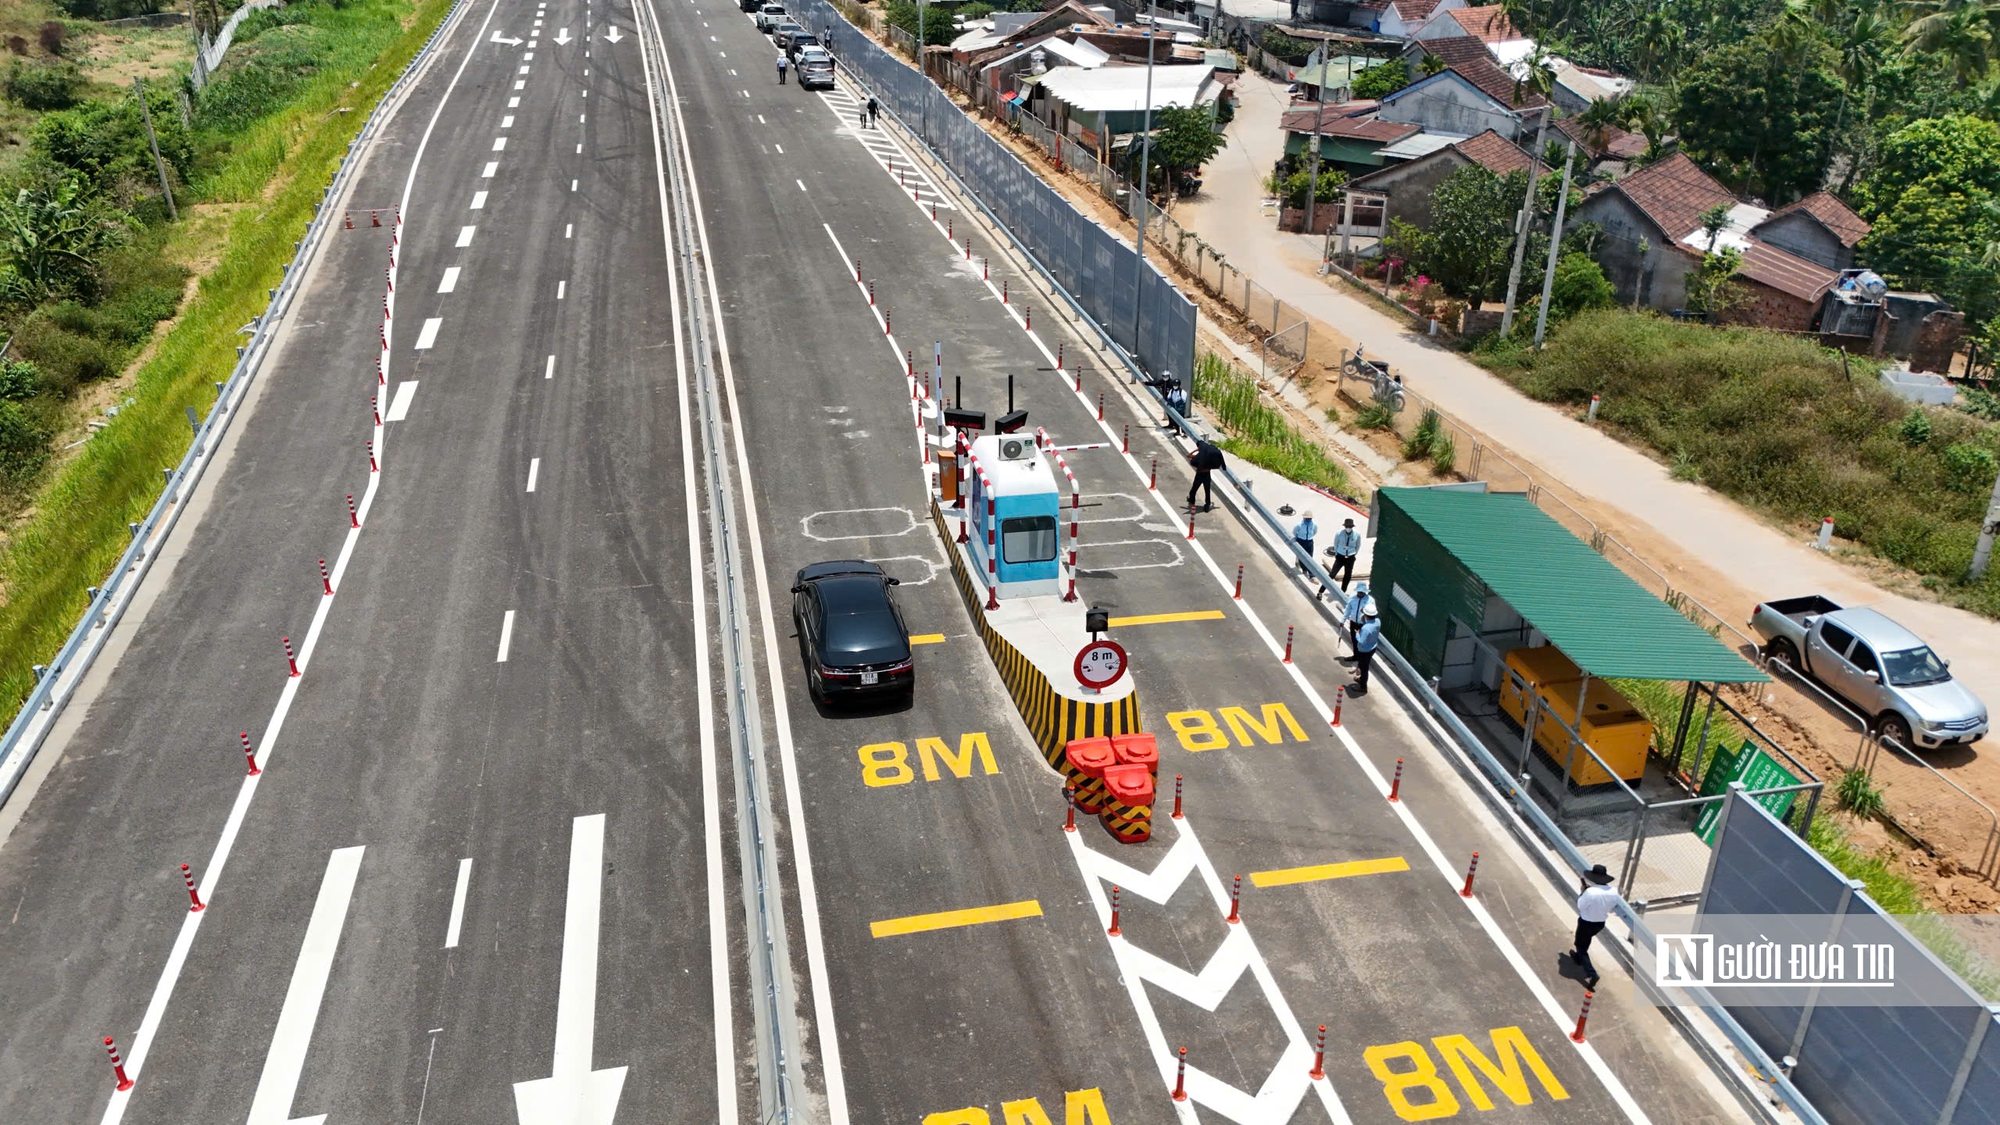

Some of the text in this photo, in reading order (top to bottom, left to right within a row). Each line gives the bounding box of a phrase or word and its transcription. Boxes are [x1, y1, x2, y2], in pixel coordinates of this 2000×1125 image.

[1091, 651, 1113, 661] 8 m
[1166, 702, 1309, 752] 8M
[857, 732, 1000, 788] 8M
[1734, 748, 1751, 772] VETC
[1363, 1026, 1571, 1122] 8M
